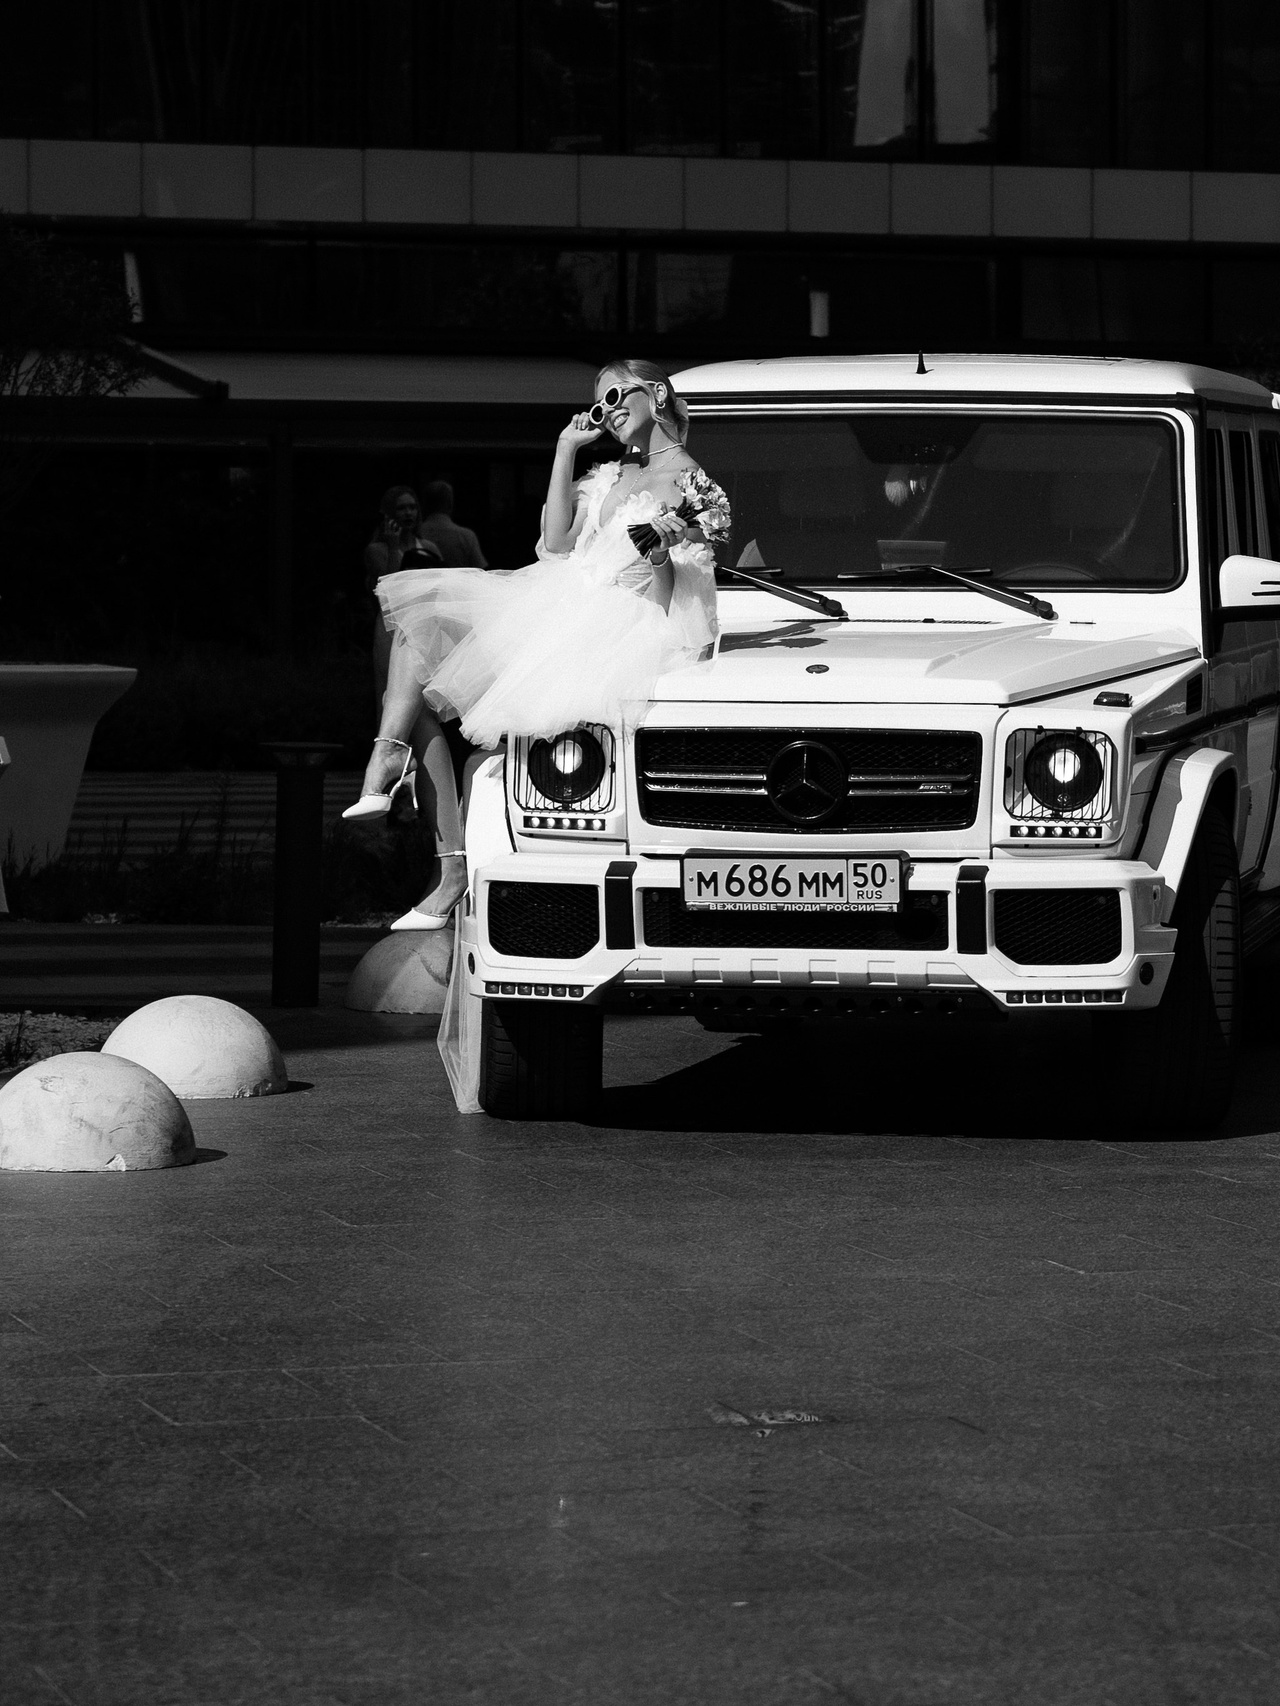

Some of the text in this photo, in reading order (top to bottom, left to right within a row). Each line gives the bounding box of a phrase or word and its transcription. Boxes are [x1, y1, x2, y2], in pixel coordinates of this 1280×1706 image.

[852, 862, 887, 888] 50
[857, 890, 883, 900] RUS
[709, 903, 875, 912] ВЕЖЛИВЫЕ ЛЮДИ РОССИИ
